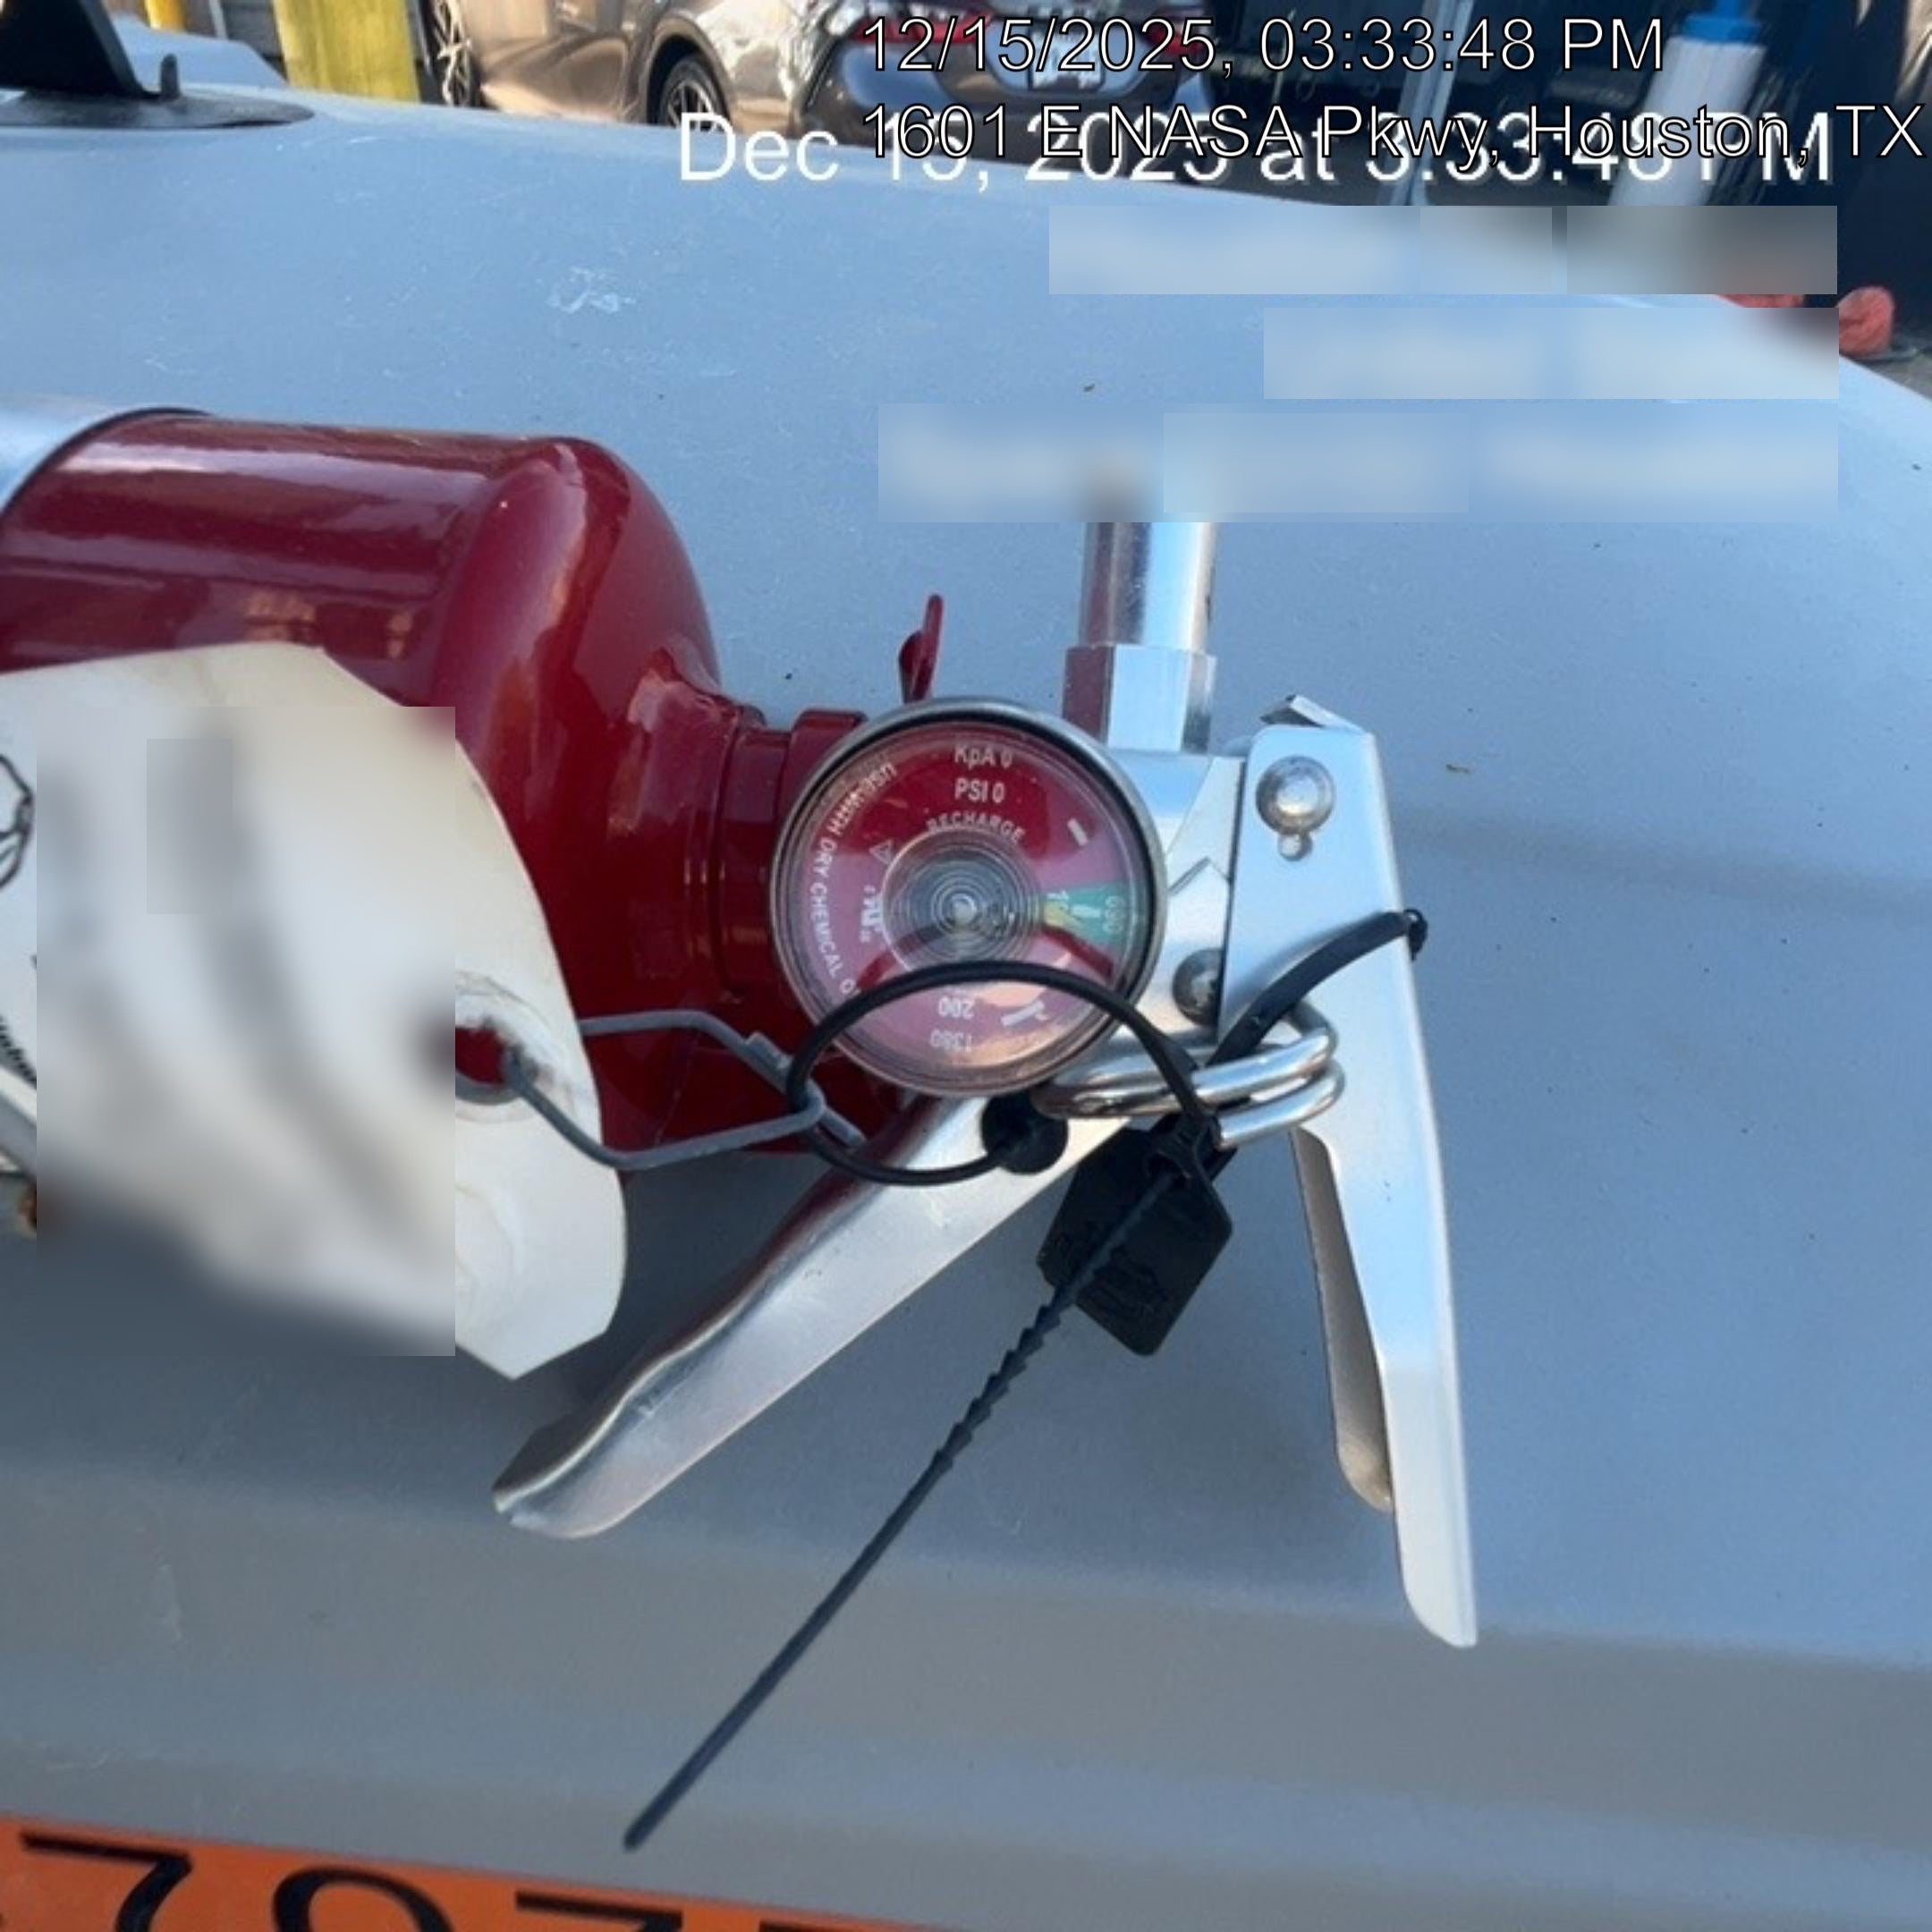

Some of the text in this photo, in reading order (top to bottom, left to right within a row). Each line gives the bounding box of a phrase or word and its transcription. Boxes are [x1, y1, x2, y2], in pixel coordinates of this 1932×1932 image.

[953, 777, 1006, 804] PSI 0
[927, 810, 1027, 843] RECHARGE
[812, 836, 838, 878] DRY
[809, 882, 843, 979] CHEMICAL
